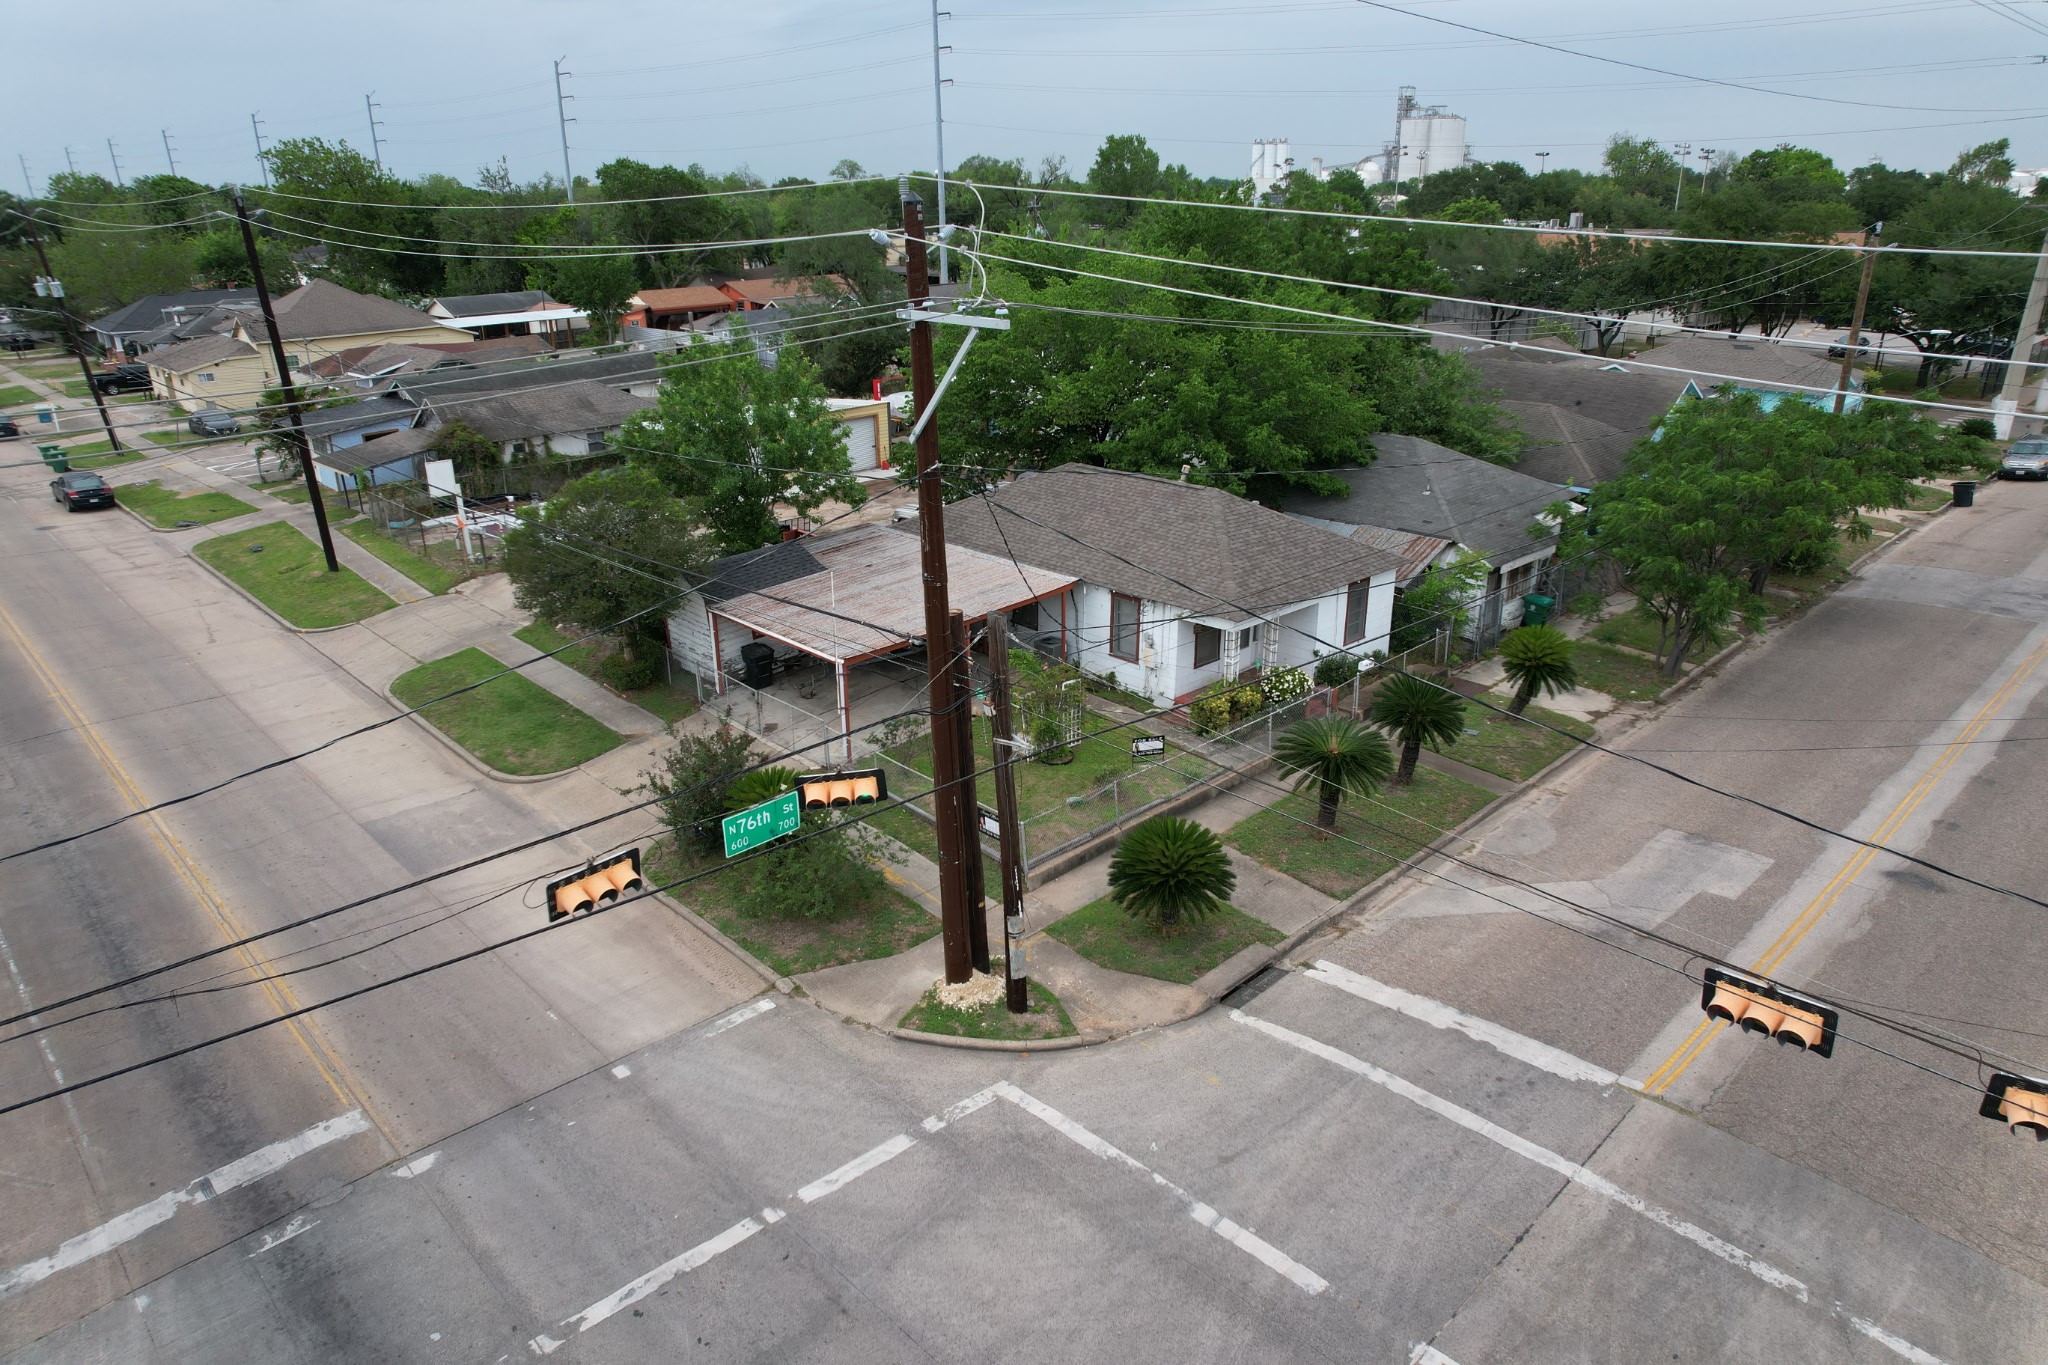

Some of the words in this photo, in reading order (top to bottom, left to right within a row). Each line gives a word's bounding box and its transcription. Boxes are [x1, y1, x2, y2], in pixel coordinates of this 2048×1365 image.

[731, 836, 749, 850] 600
[778, 816, 795, 831] 700
[736, 810, 771, 834] 76th
[782, 802, 794, 814] St
